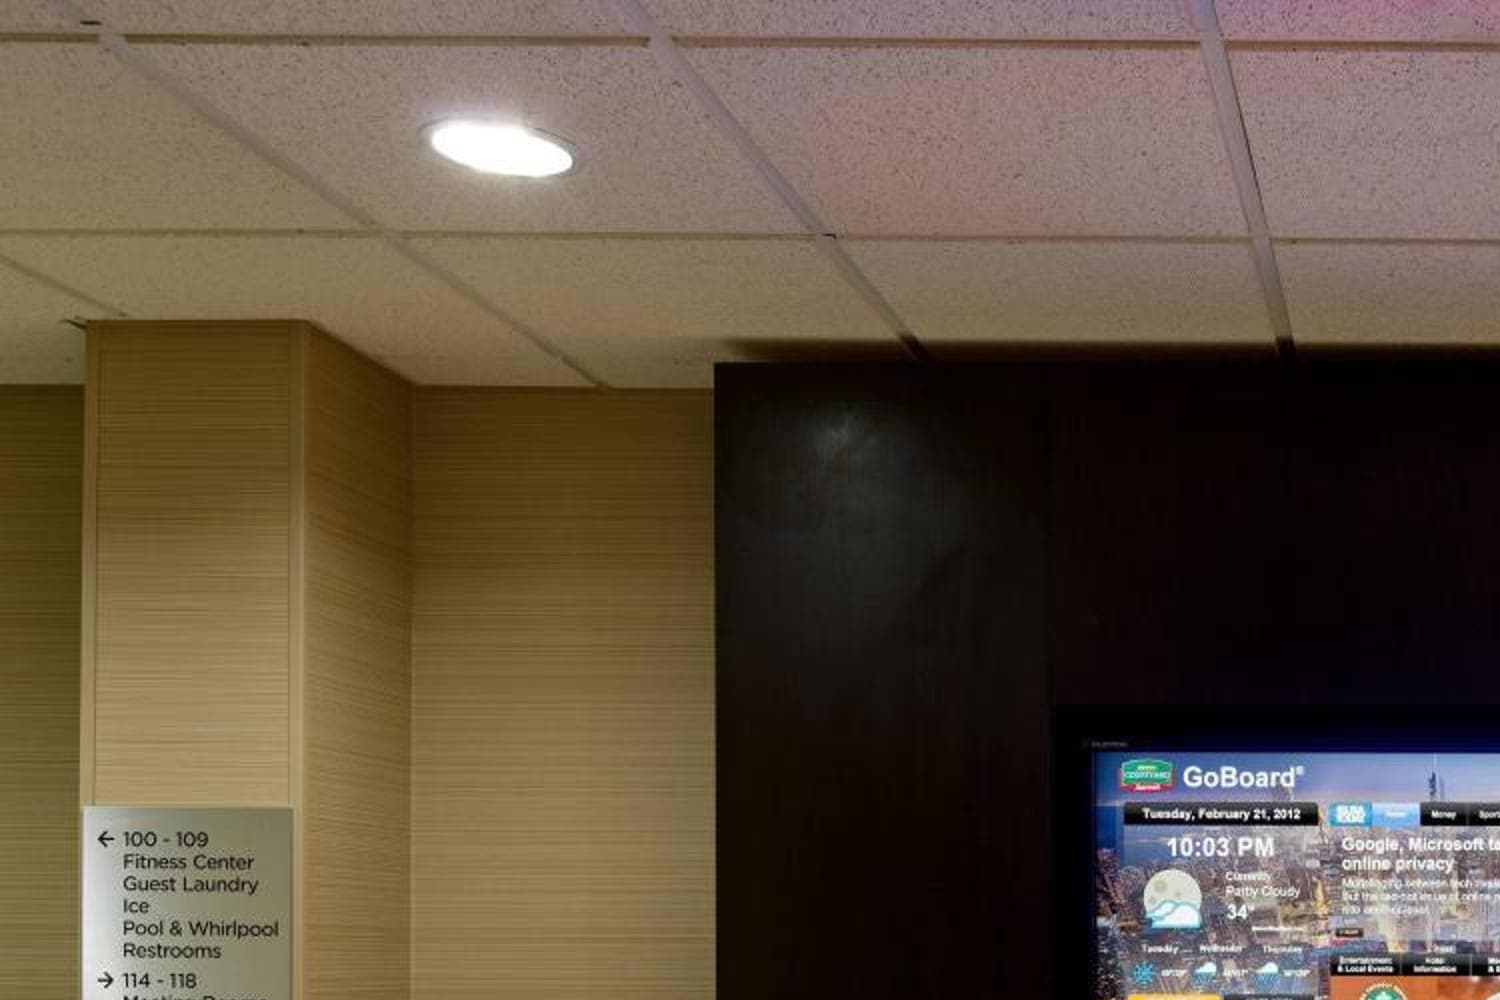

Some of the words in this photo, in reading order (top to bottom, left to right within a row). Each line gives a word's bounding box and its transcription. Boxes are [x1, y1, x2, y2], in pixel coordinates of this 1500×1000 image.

[1142, 807, 1196, 822] Tuesday,
[1199, 807, 1250, 822] February
[1253, 807, 1270, 821] 21,
[1273, 807, 1301, 820] 2012
[123, 831, 157, 847] 100
[176, 831, 209, 847] 109
[1167, 837, 1229, 857] 10:03
[1238, 837, 1275, 857] PM
[1342, 838, 1403, 854] Google,
[1409, 837, 1484, 851] Microsoft
[123, 853, 187, 870] Fitness
[193, 853, 255, 870] Center
[1342, 857, 1391, 871] online
[1396, 858, 1455, 873] privacy
[123, 875, 176, 892] Guest
[183, 875, 259, 896] Laundry
[123, 899, 150, 914] Ice
[123, 920, 163, 937] Pool
[169, 921, 182, 937] &
[189, 920, 279, 940] Whirlpool
[123, 942, 222, 959] Restrooms
[122, 973, 150, 989] 114
[169, 973, 197, 989] 118
